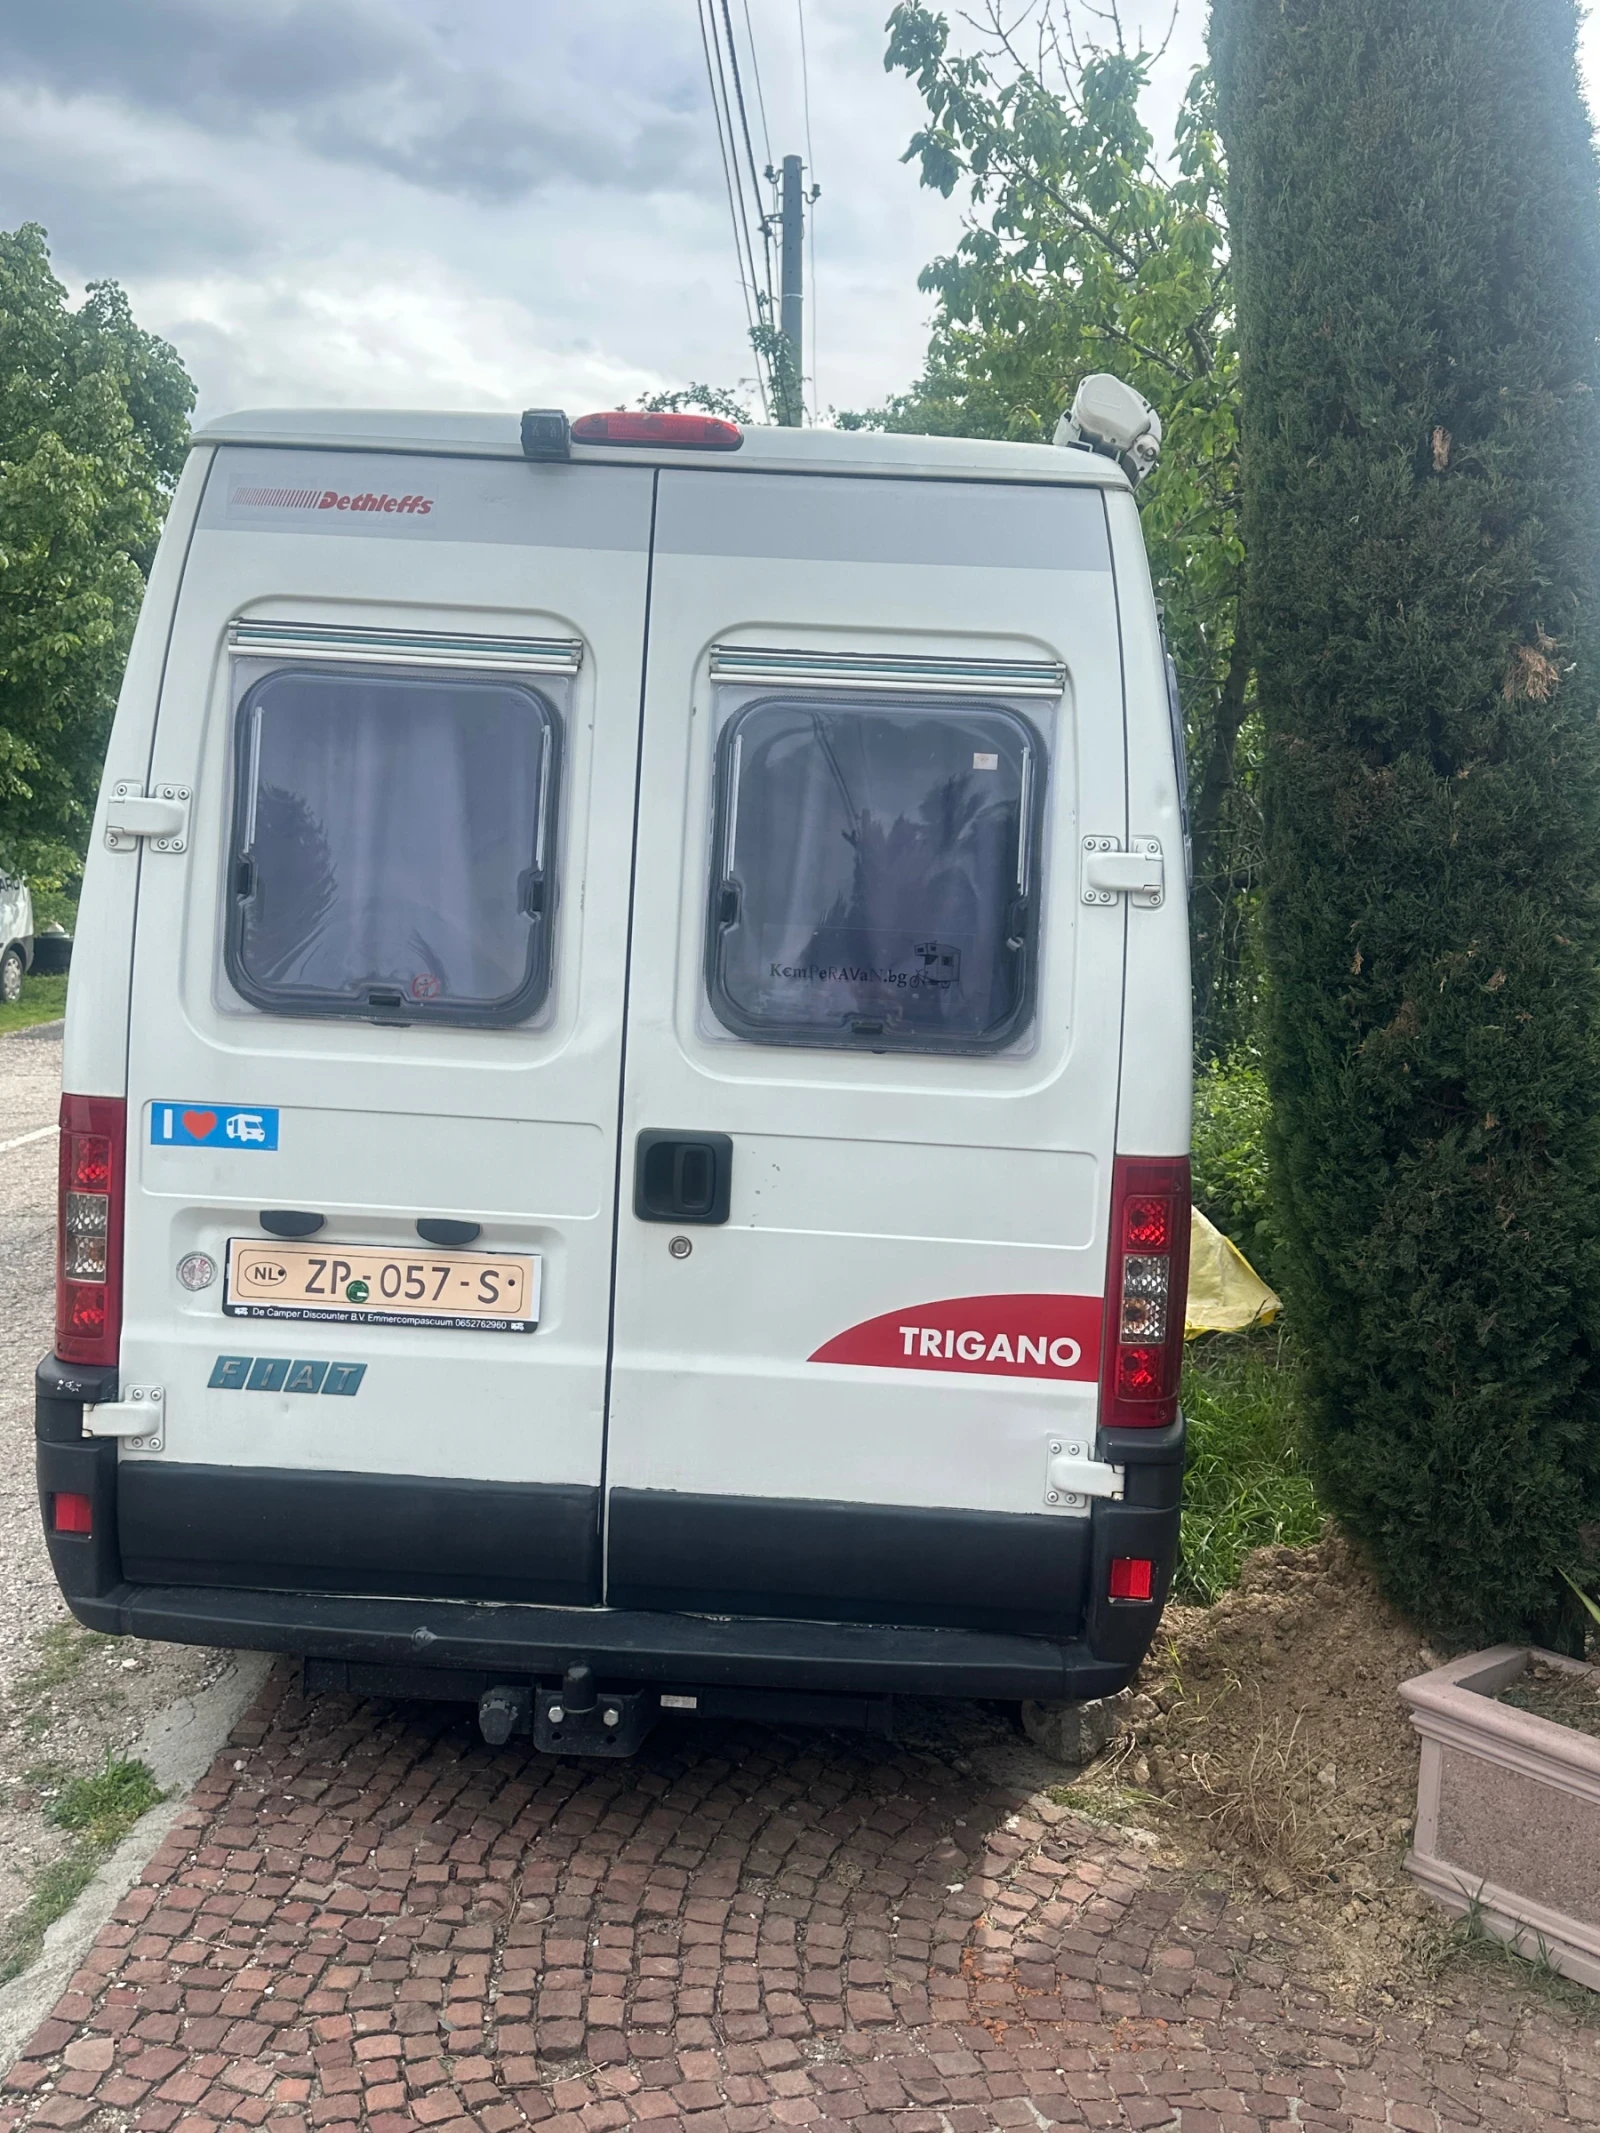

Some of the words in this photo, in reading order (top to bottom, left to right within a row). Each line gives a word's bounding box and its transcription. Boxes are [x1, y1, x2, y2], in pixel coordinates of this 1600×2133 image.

[318, 490, 434, 515] Dethleffs
[163, 1108, 173, 1139] I
[254, 1266, 279, 1282] NL
[252, 1307, 265, 1317] De
[266, 1308, 301, 1320] Camper
[302, 1310, 349, 1321] Discounter
[367, 1313, 454, 1327] Emmercompascuum
[899, 1325, 1082, 1368] TRIGANO
[217, 1360, 359, 1393] FIAT
